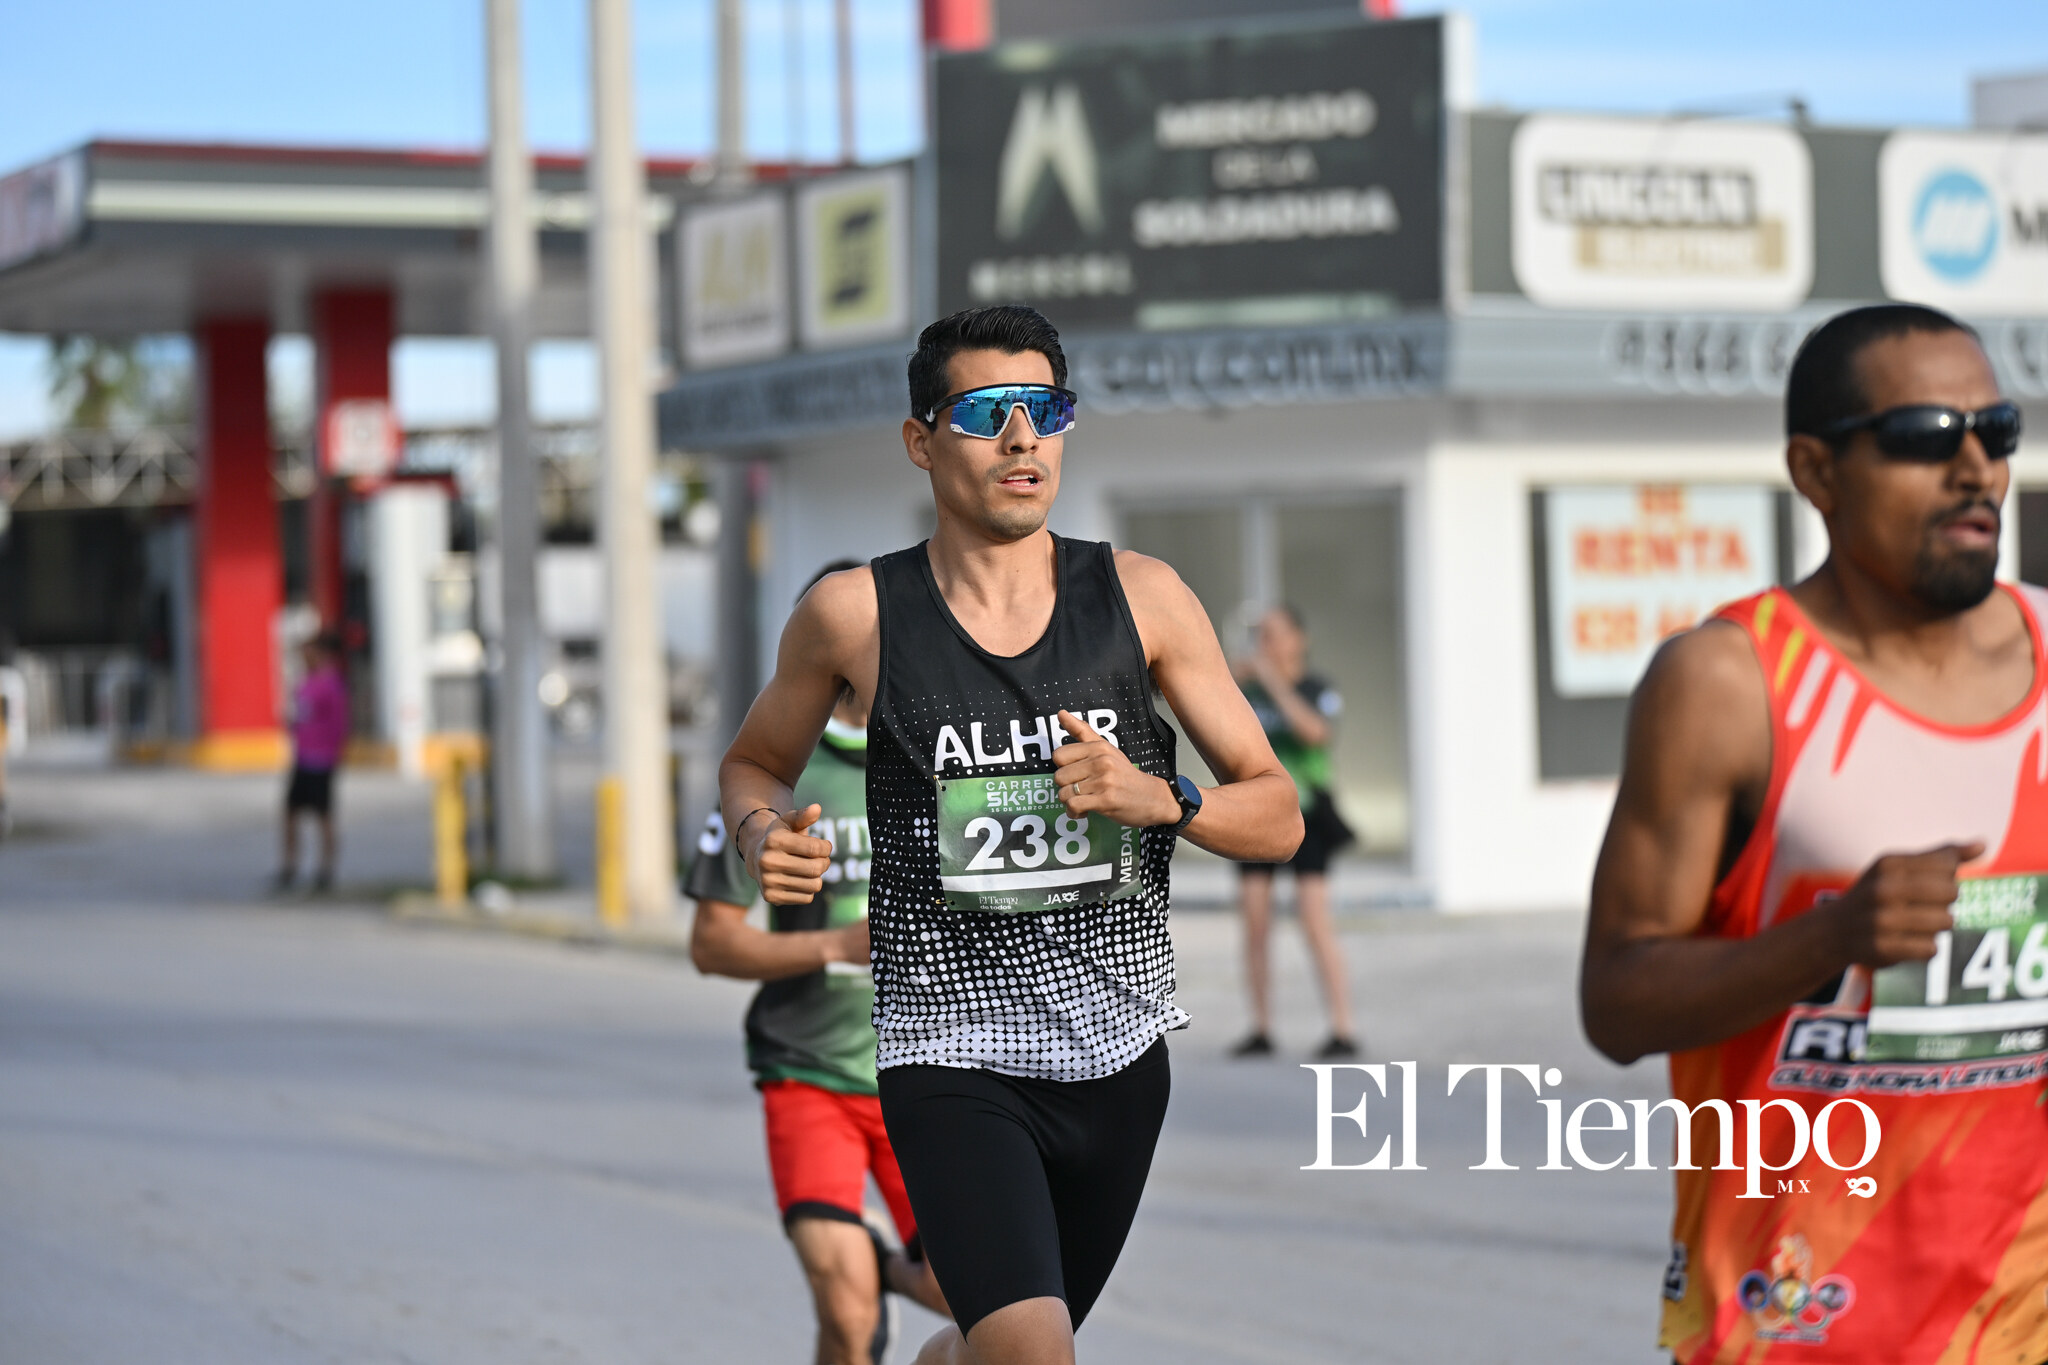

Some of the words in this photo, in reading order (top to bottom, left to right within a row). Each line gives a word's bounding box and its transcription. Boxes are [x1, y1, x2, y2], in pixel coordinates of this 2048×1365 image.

[1157, 90, 1376, 147] MERCADO
[1133, 187, 1397, 248] SOLDADURA
[1575, 530, 1748, 571] RENTA
[986, 779, 1056, 791] CARRER
[964, 814, 1091, 871] 238
[987, 896, 1019, 906] Tiempo
[1925, 921, 2048, 1006] 146
